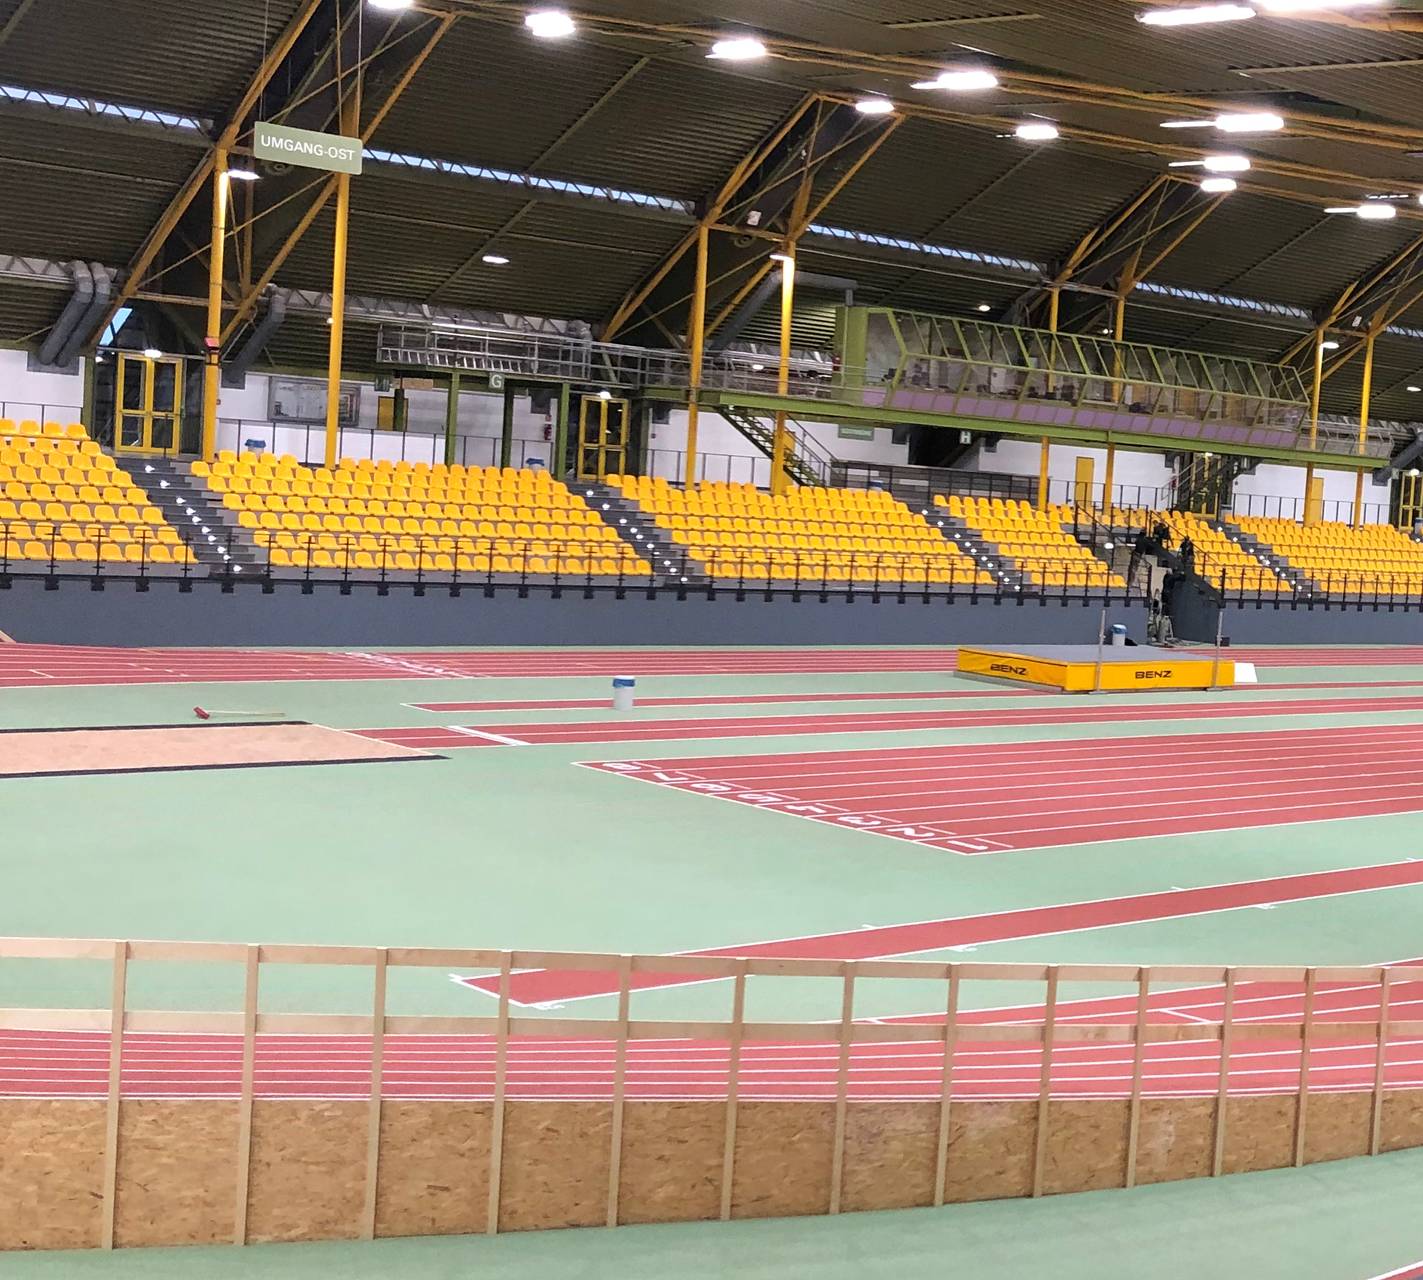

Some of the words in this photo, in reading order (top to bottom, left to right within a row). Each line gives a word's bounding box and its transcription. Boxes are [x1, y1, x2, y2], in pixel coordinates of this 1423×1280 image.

[261, 134, 356, 161] UMGANG-OST
[491, 374, 503, 388] G
[960, 431, 971, 444] H
[990, 663, 1027, 676] BENZ
[1135, 670, 1172, 679] BENZ
[886, 827, 935, 838] 2
